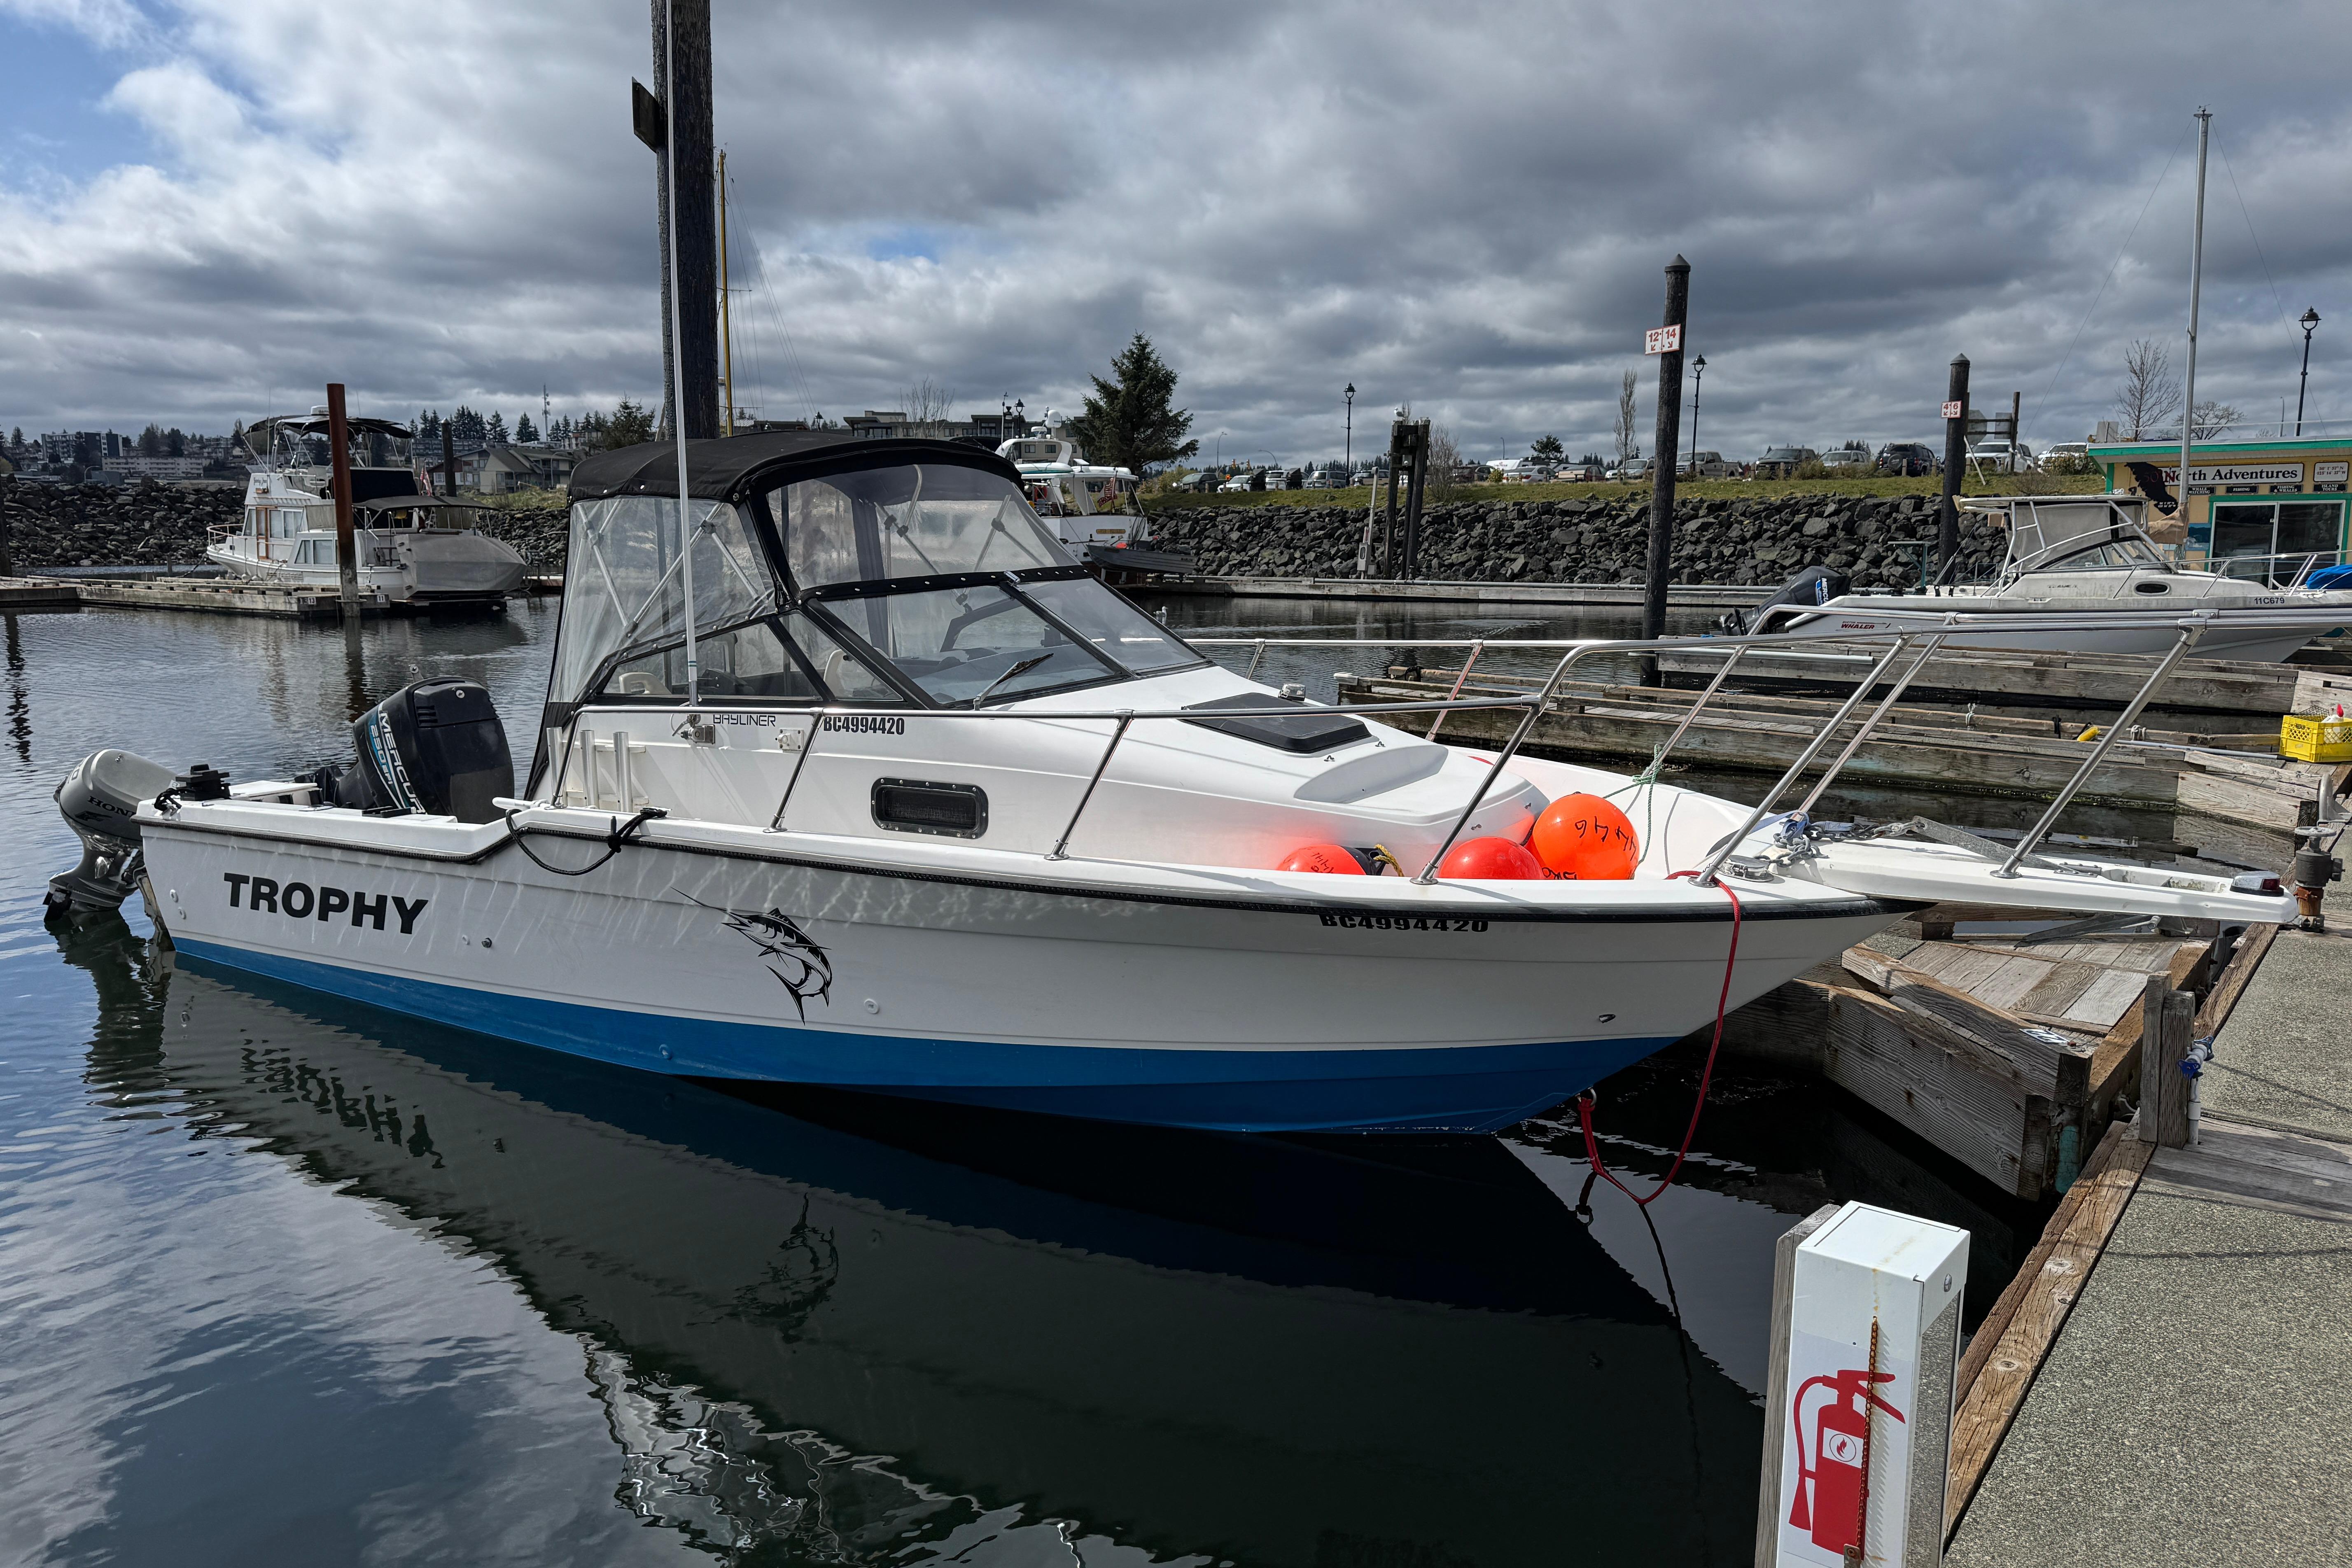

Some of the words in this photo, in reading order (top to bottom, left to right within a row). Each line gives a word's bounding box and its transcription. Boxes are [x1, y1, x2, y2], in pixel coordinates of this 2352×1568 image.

[1649, 331, 1659, 343] 12
[1666, 328, 1676, 339] 14
[2211, 468, 2297, 481] Adventures
[713, 714, 776, 727] BAYLINER
[823, 716, 905, 735] BC4994420
[371, 724, 387, 763] 250
[380, 712, 426, 814] MERCUR
[224, 873, 428, 934] TROPHY
[1319, 915, 1489, 932] BC4994420
